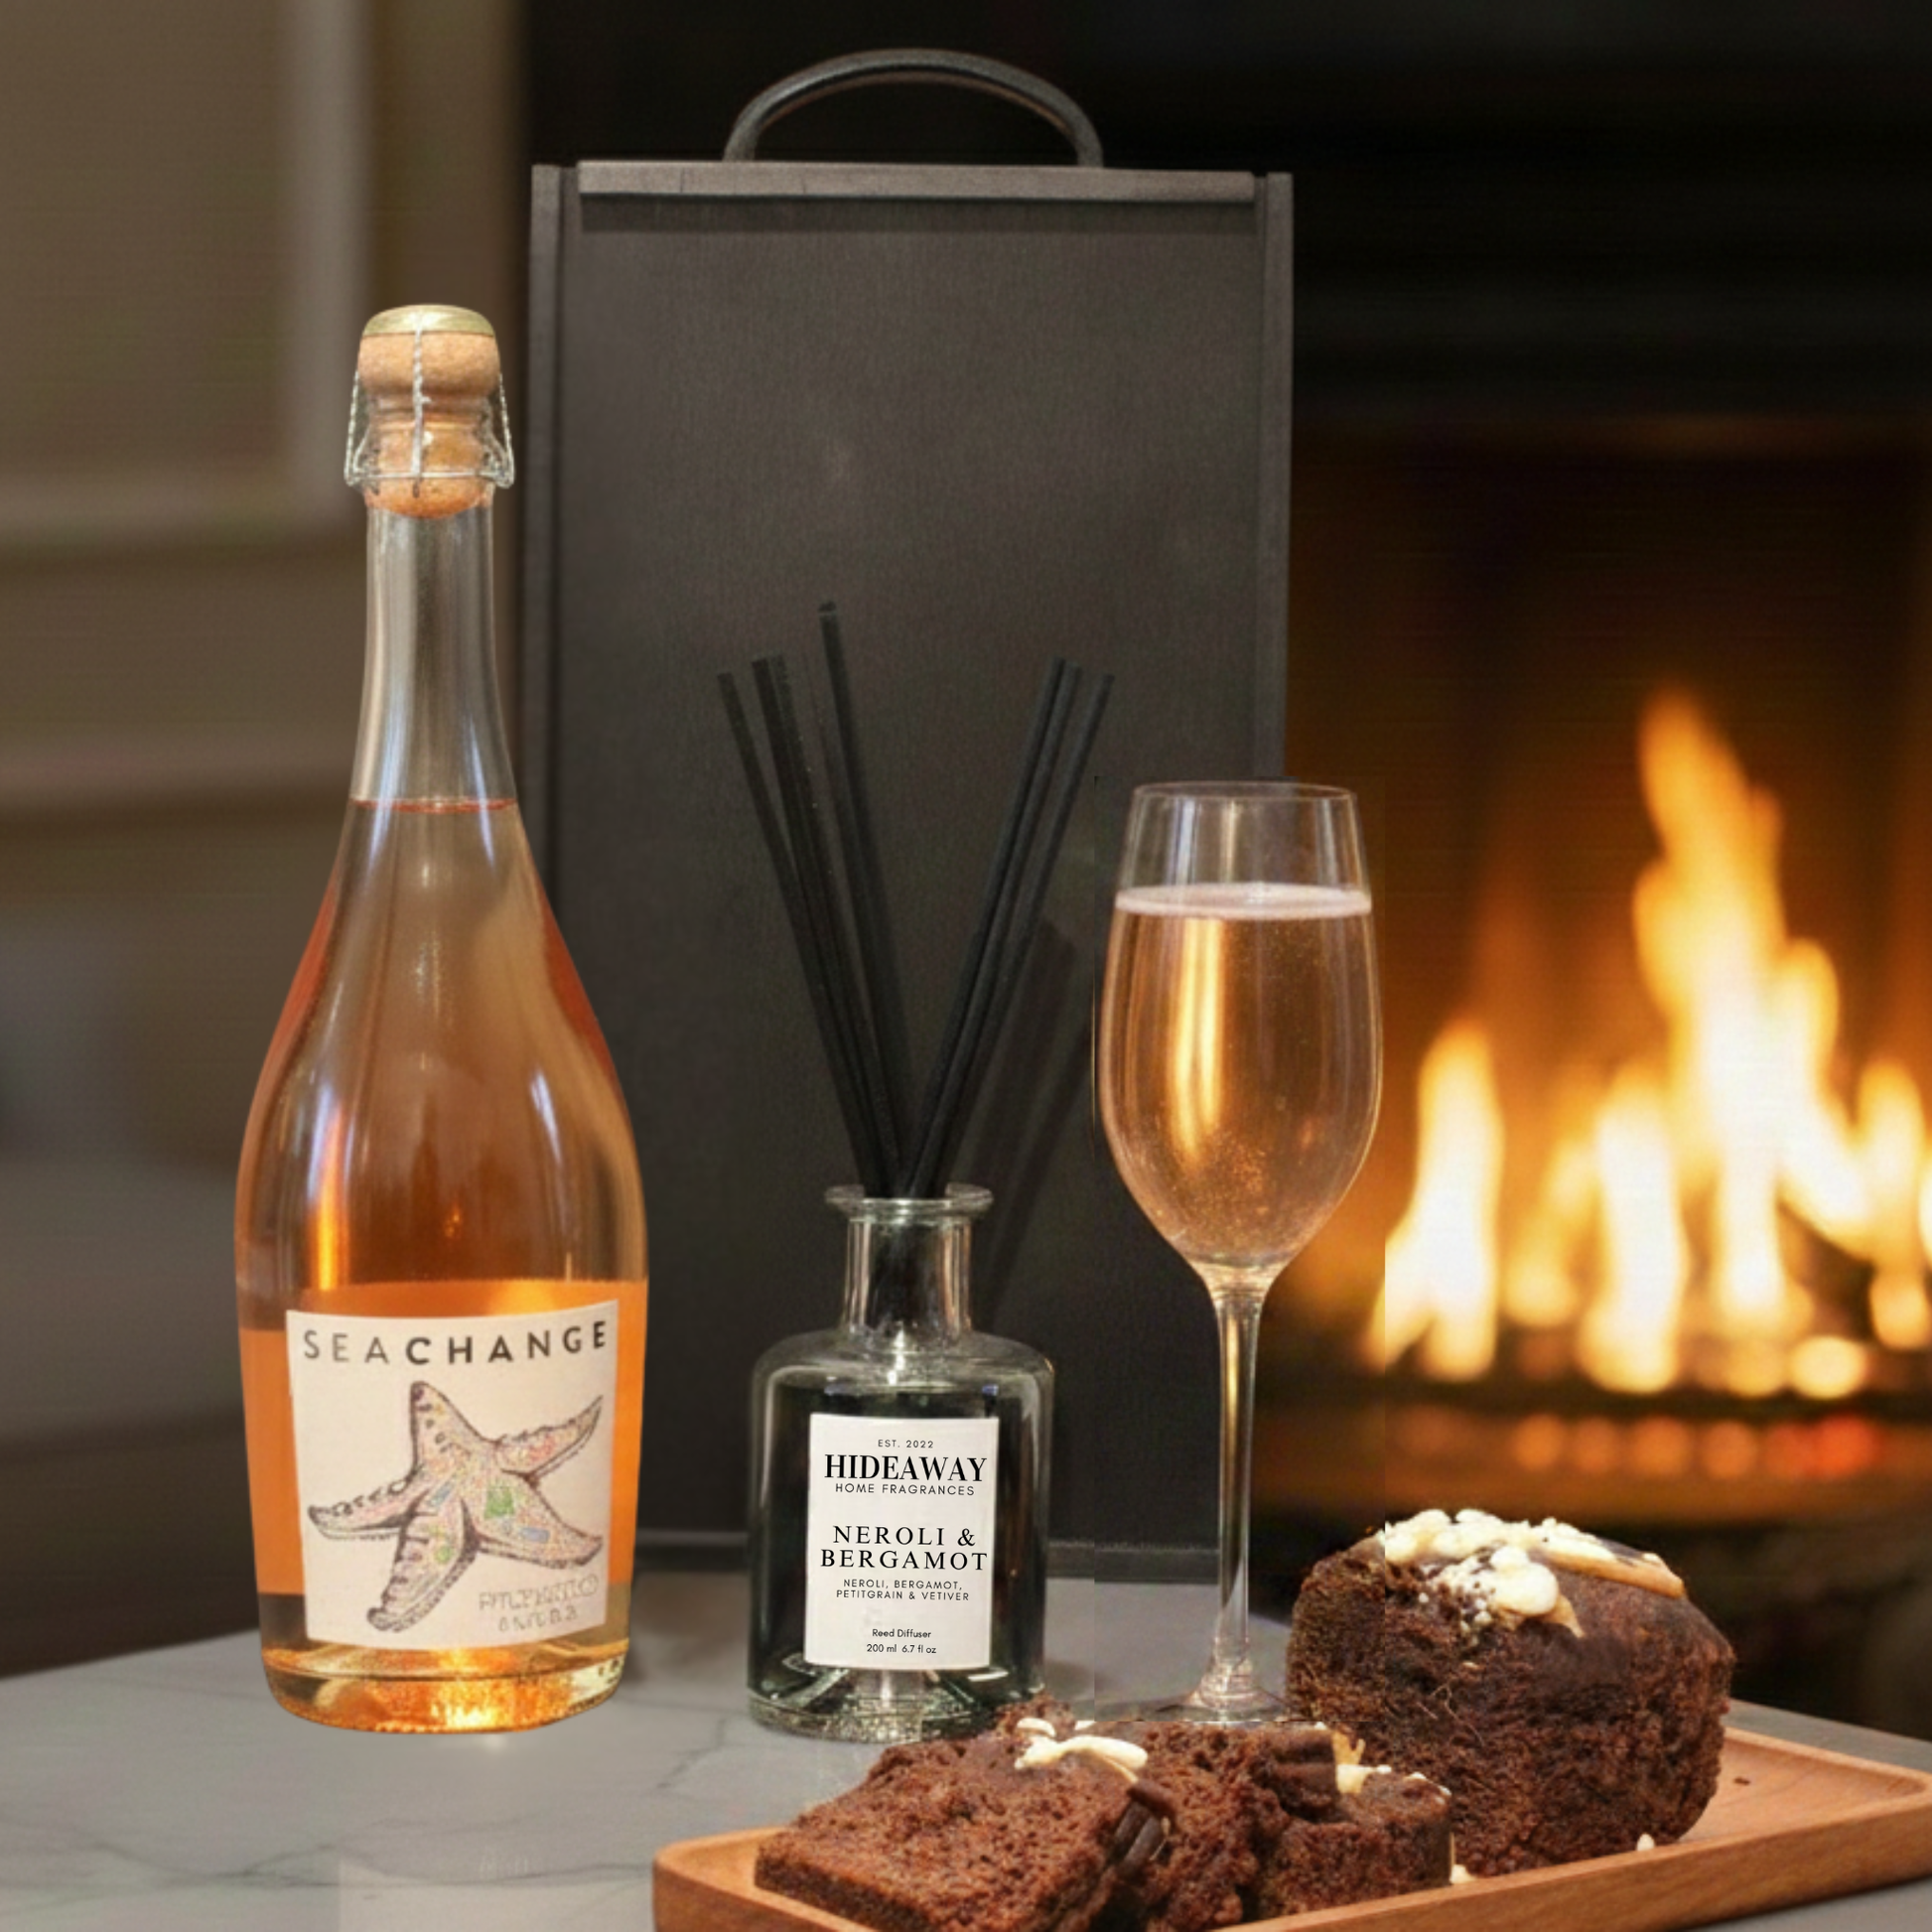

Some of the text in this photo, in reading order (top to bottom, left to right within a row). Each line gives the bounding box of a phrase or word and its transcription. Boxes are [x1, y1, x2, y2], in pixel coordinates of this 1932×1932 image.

[878, 1439, 934, 1449] EST. 2022
[824, 1453, 988, 1482] HIDEAWAY
[835, 1482, 975, 1496] HOME FRAGRANCES
[833, 1525, 976, 1547] NEROLI &
[820, 1549, 988, 1571] BERGAMOT
[843, 1579, 962, 1591] NEROLI, BERGAMOT,
[836, 1589, 969, 1601] PETITGRAIN & VETIVER
[872, 1628, 932, 1639] Reed Diffuser
[866, 1643, 937, 1655] 200 ml 6.7 fl oz
